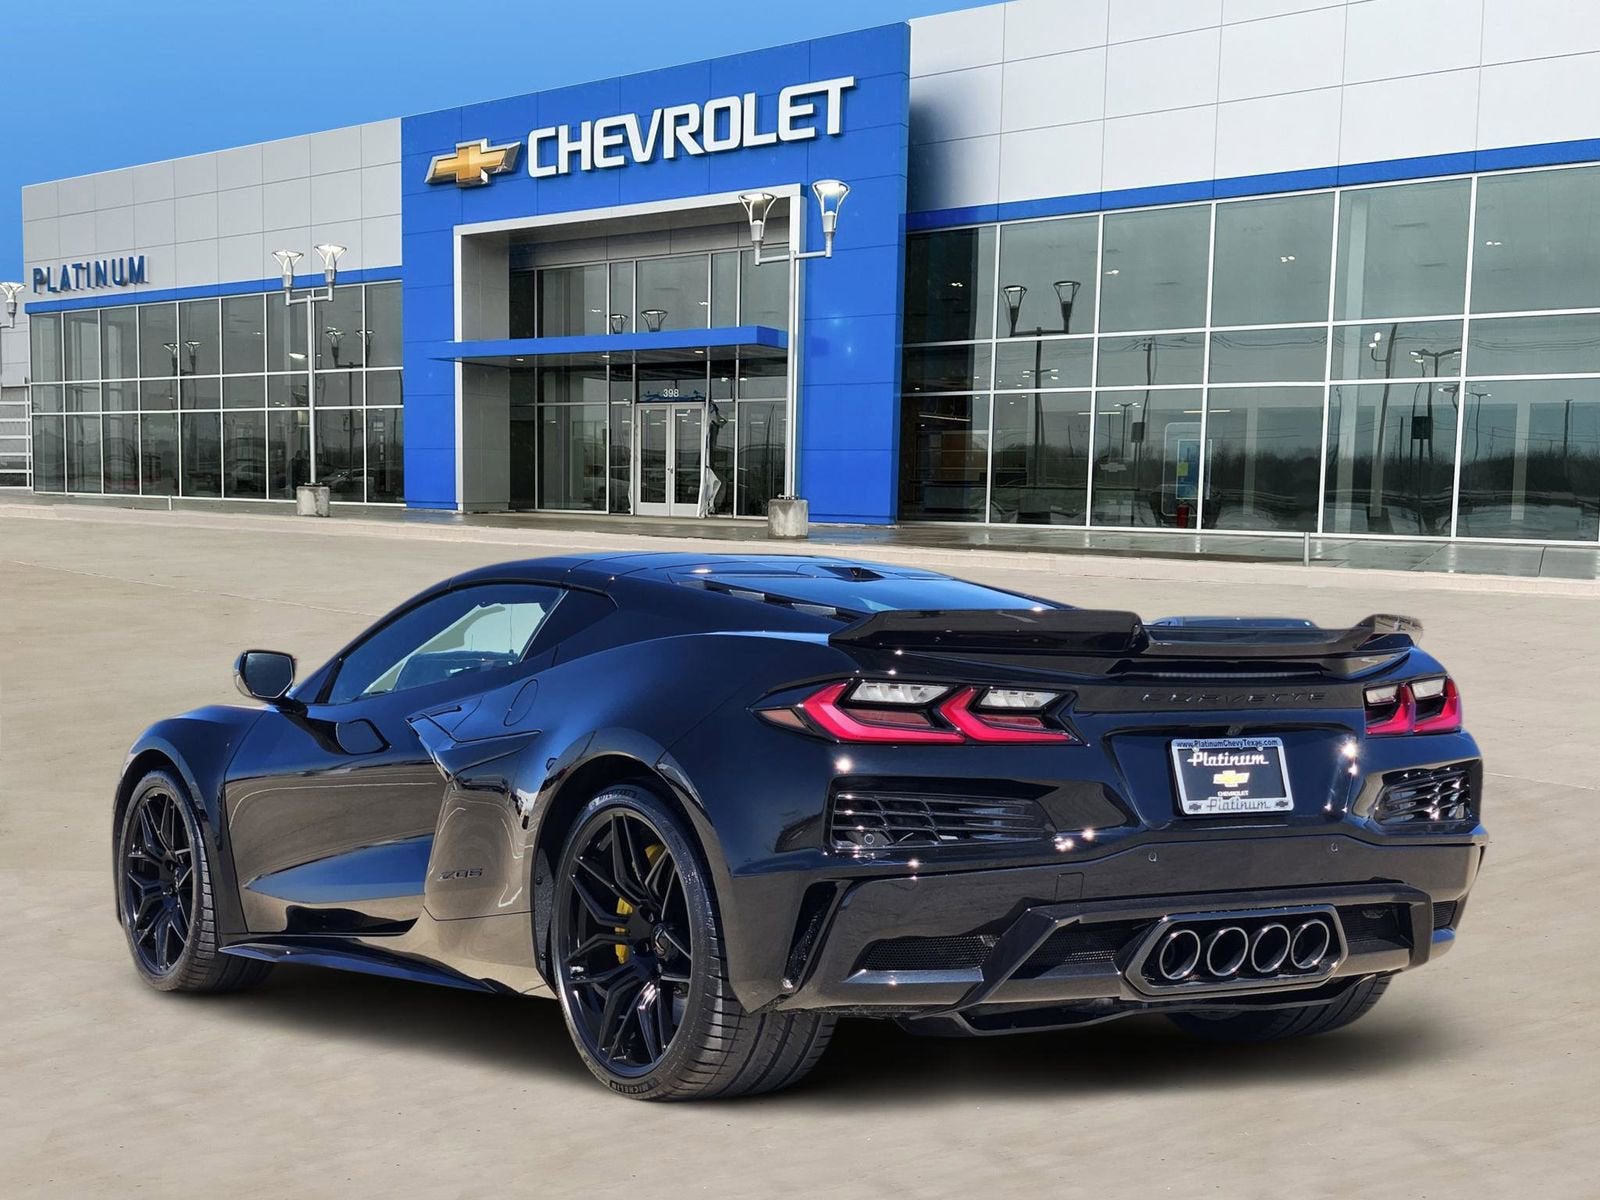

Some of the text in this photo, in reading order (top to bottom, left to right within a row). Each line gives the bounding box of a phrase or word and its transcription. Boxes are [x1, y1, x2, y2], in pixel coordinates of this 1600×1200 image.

[528, 76, 854, 177] CHEVROLET
[33, 256, 145, 293] PLATINUM
[663, 389, 679, 398] 398
[1142, 692, 1326, 703] CORVETTE
[1176, 739, 1278, 748] www.PlatinumChevyTexas.com
[1187, 752, 1269, 766] Platinum
[1207, 800, 1271, 811] Platinum
[611, 1081, 649, 1094] MICHELIN
